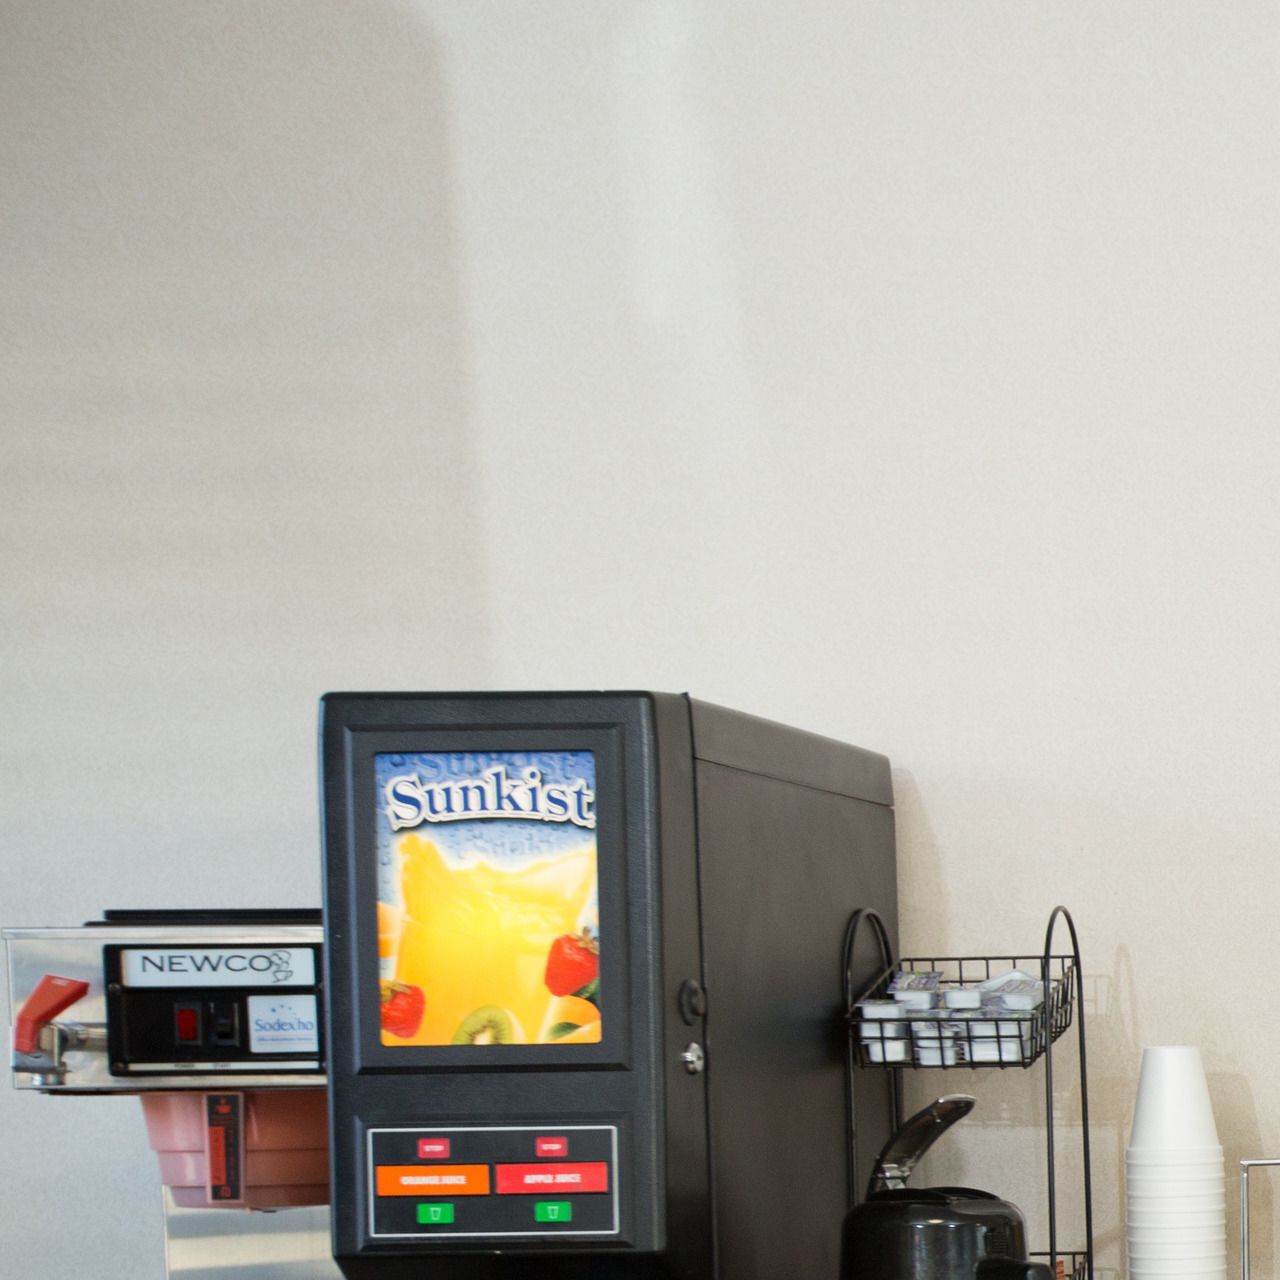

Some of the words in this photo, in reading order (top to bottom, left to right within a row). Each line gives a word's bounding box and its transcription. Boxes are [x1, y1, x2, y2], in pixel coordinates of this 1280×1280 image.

[386, 766, 596, 831] Sunkist
[141, 954, 273, 973] NEWCO
[523, 1174, 553, 1184] APPLE
[555, 1172, 582, 1183] JUICE
